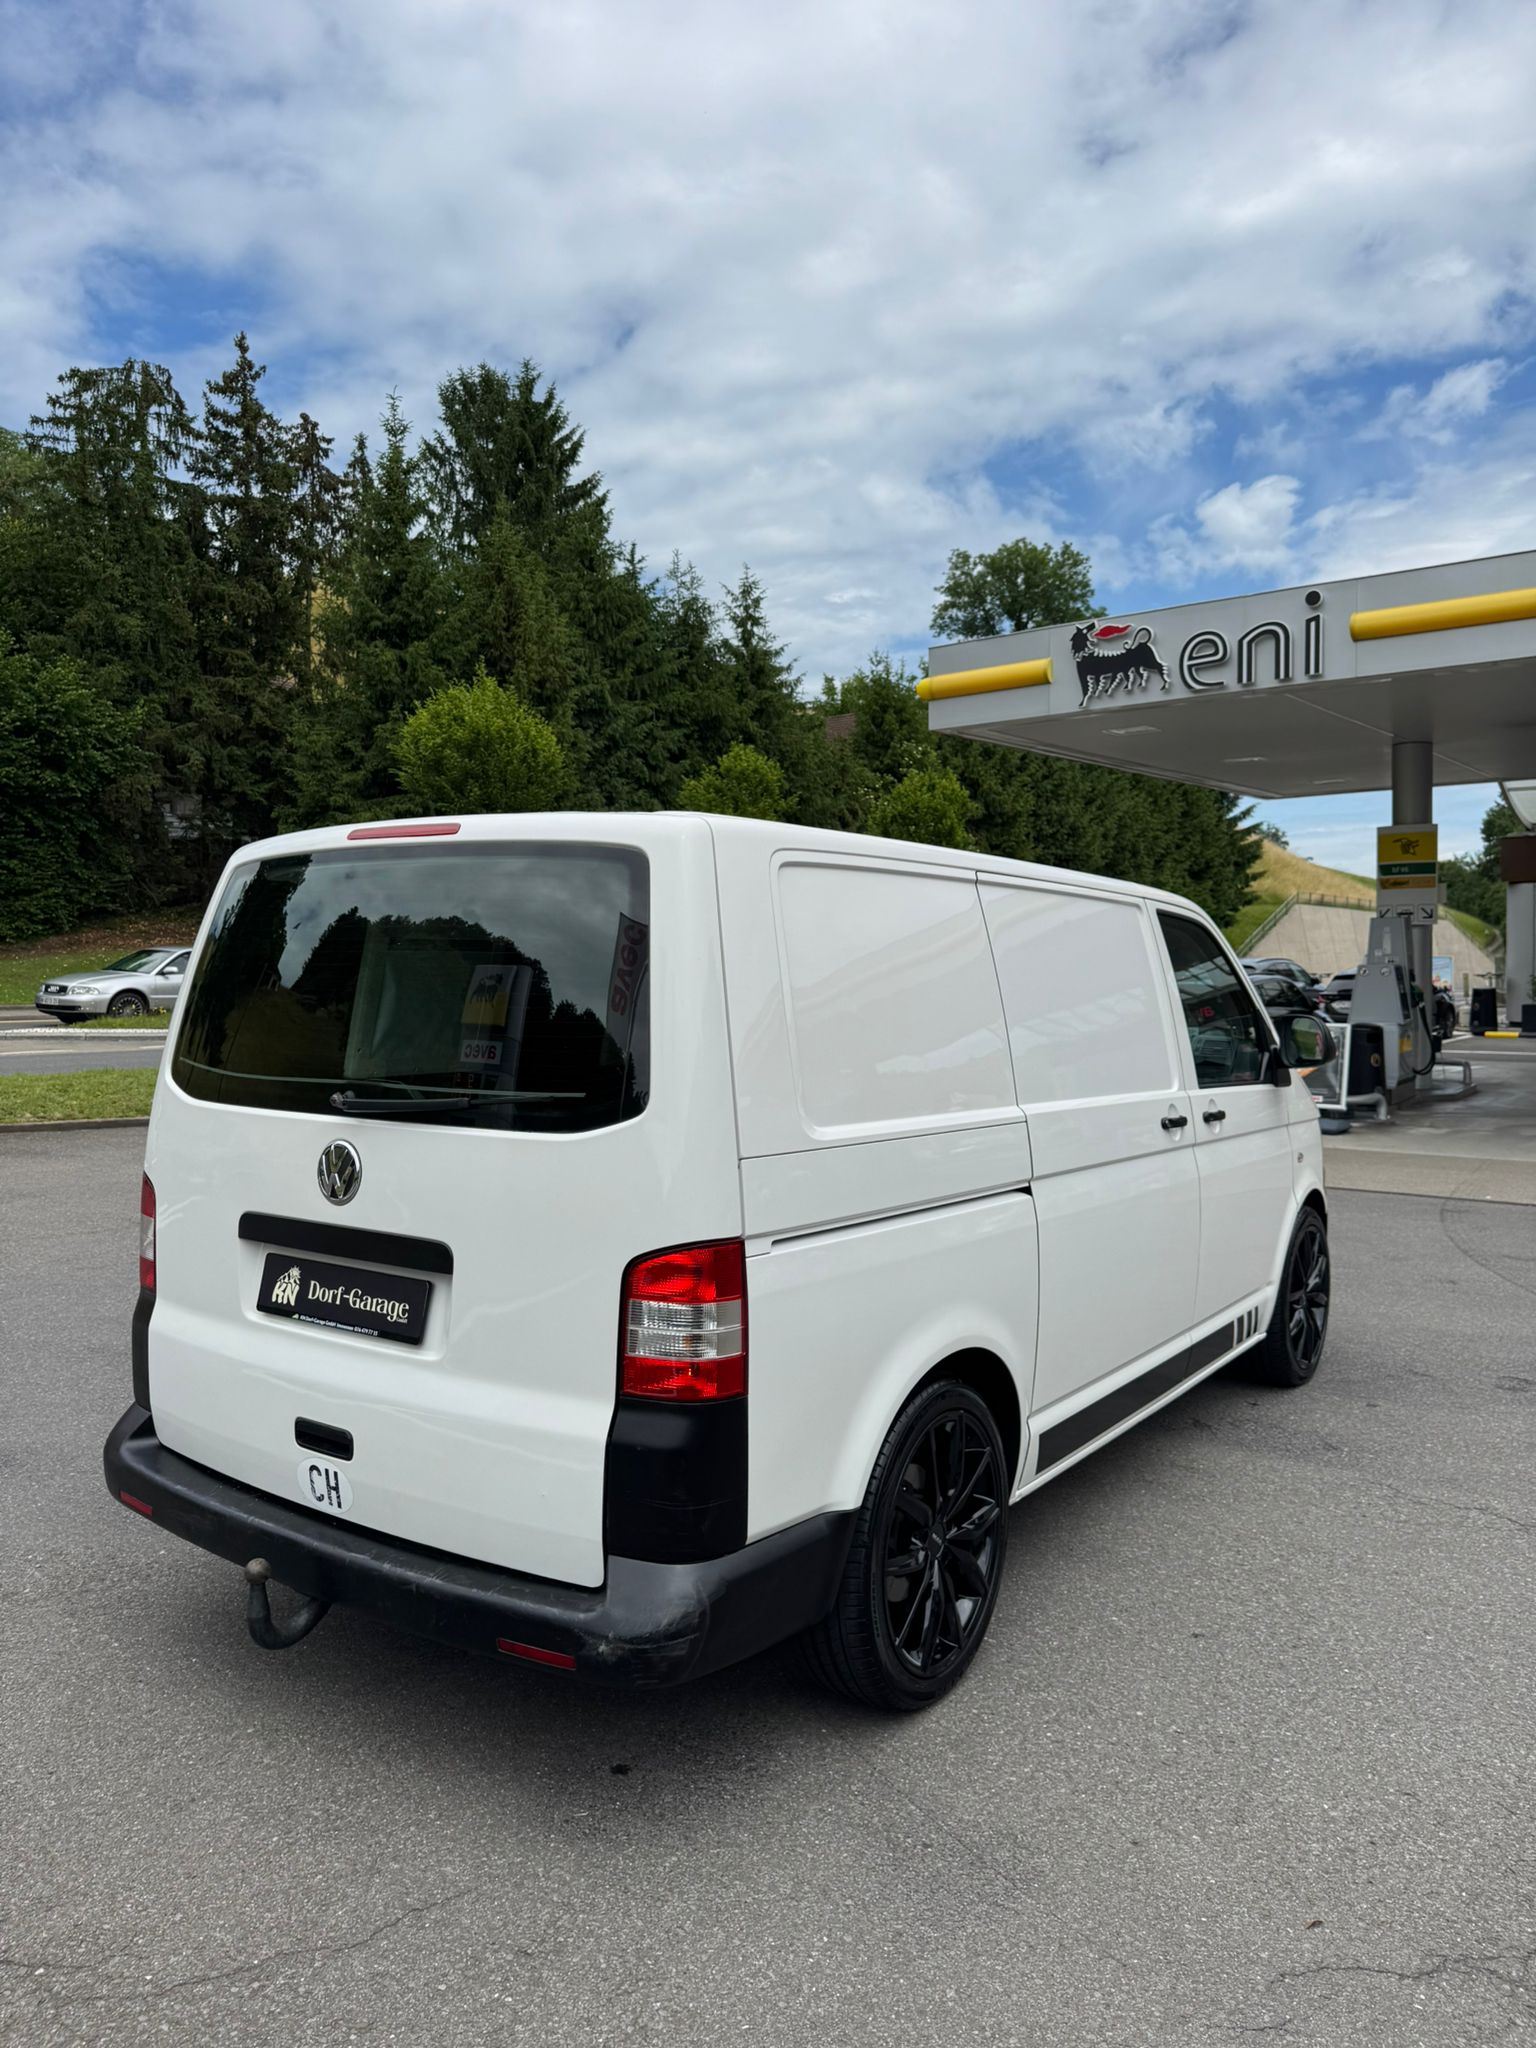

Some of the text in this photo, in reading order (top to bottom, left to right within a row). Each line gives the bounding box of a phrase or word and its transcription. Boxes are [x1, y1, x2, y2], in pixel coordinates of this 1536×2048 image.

[1179, 589, 1323, 689] eni
[272, 1280, 410, 1323] KN Dorf-Garage
[309, 1464, 342, 1509] CH
